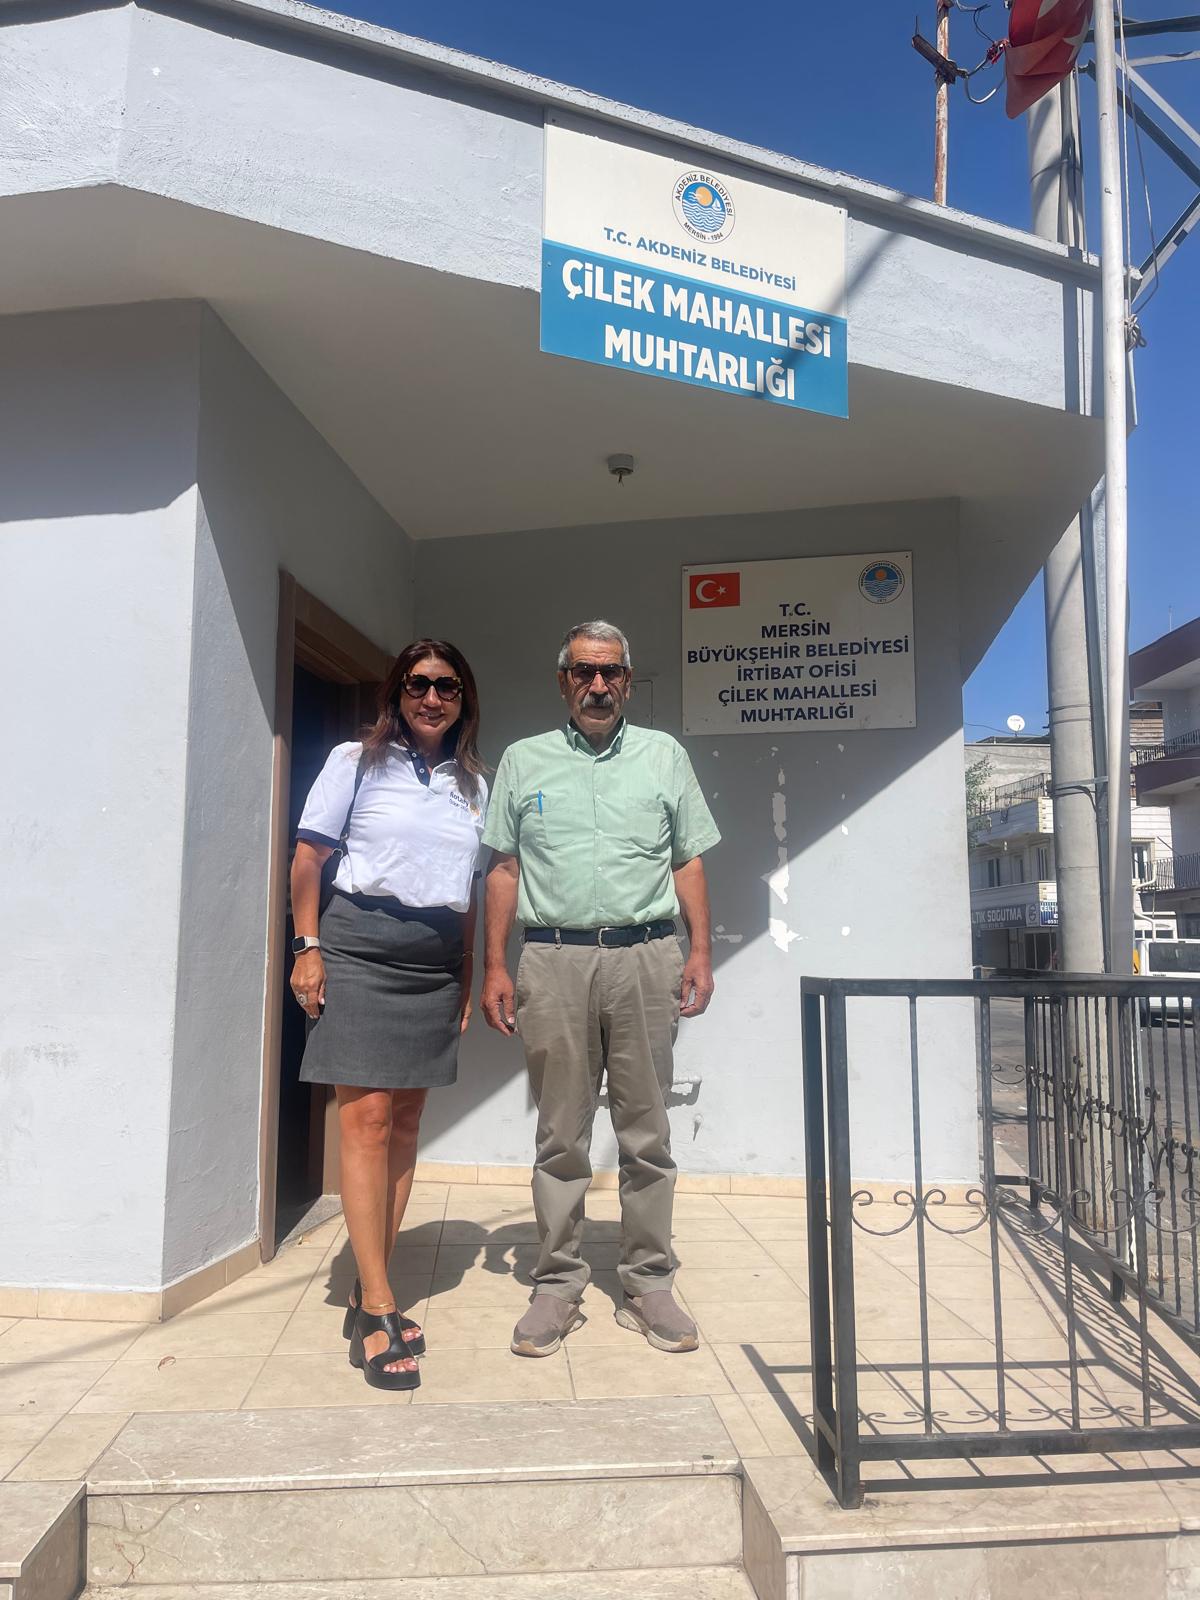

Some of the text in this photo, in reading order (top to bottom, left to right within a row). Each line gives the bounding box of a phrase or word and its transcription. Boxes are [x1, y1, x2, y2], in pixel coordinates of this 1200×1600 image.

[675, 174, 734, 216] AKDENİZ BELEDİYESİ
[683, 222, 706, 240] MERSİN
[603, 227, 796, 291] T.C. AKDENİZ BELEDİYESİ
[562, 259, 831, 358] ÇİLEK MAHALLESİ
[604, 324, 795, 401] MUHTARLIĞI
[779, 603, 811, 617] T.C.
[761, 619, 831, 639] MERSİN
[687, 635, 909, 664] BÜYÜKŞEHİR BELEDİYESİ
[737, 659, 856, 682] İRTİBAT OFİSİ
[718, 679, 877, 707] ÇİLEK MAHALLESİ
[741, 702, 854, 723] MUHTARLIĞI
